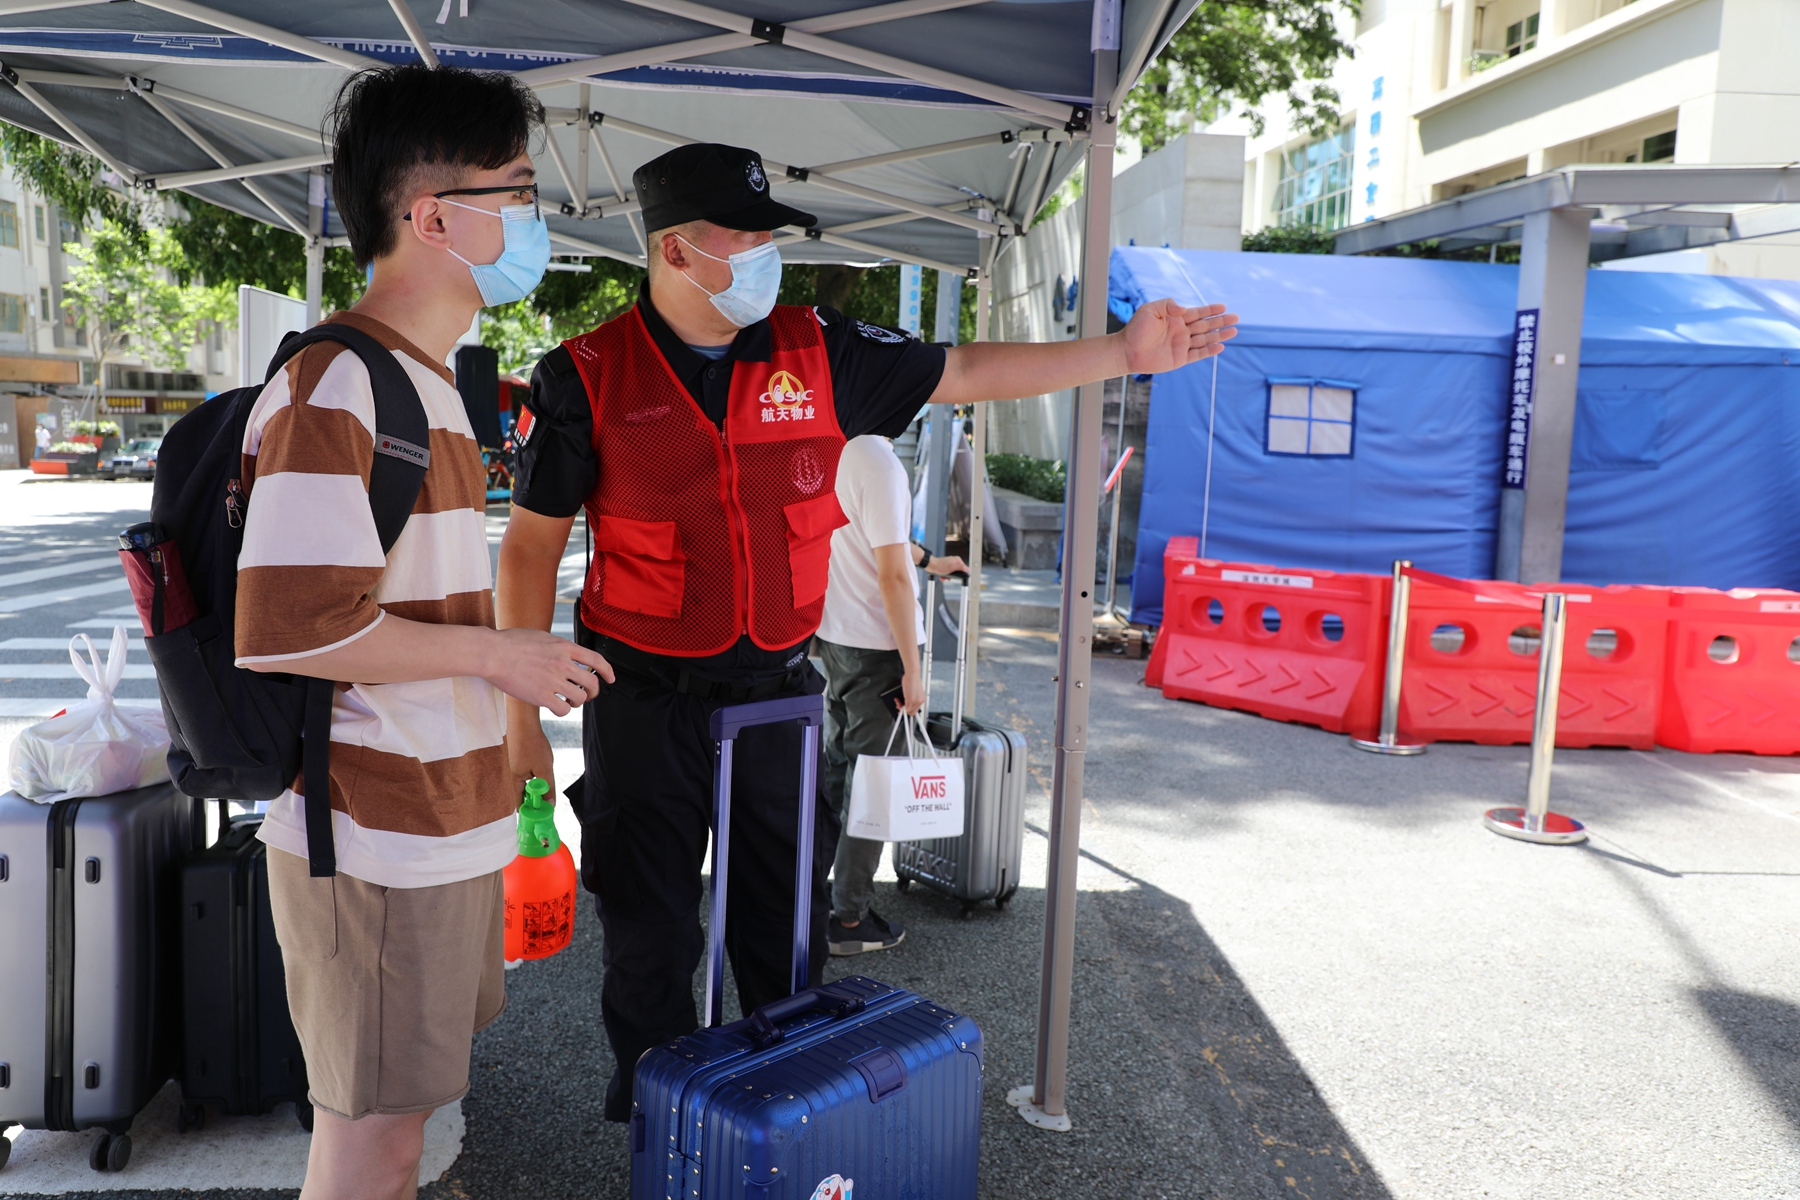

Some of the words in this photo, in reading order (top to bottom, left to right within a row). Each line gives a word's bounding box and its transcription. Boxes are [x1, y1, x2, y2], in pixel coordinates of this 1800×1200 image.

[761, 405, 815, 422] 航天物业
[391, 443, 424, 460] WENGER
[911, 775, 946, 799] VANS
[921, 804, 933, 812] THE
